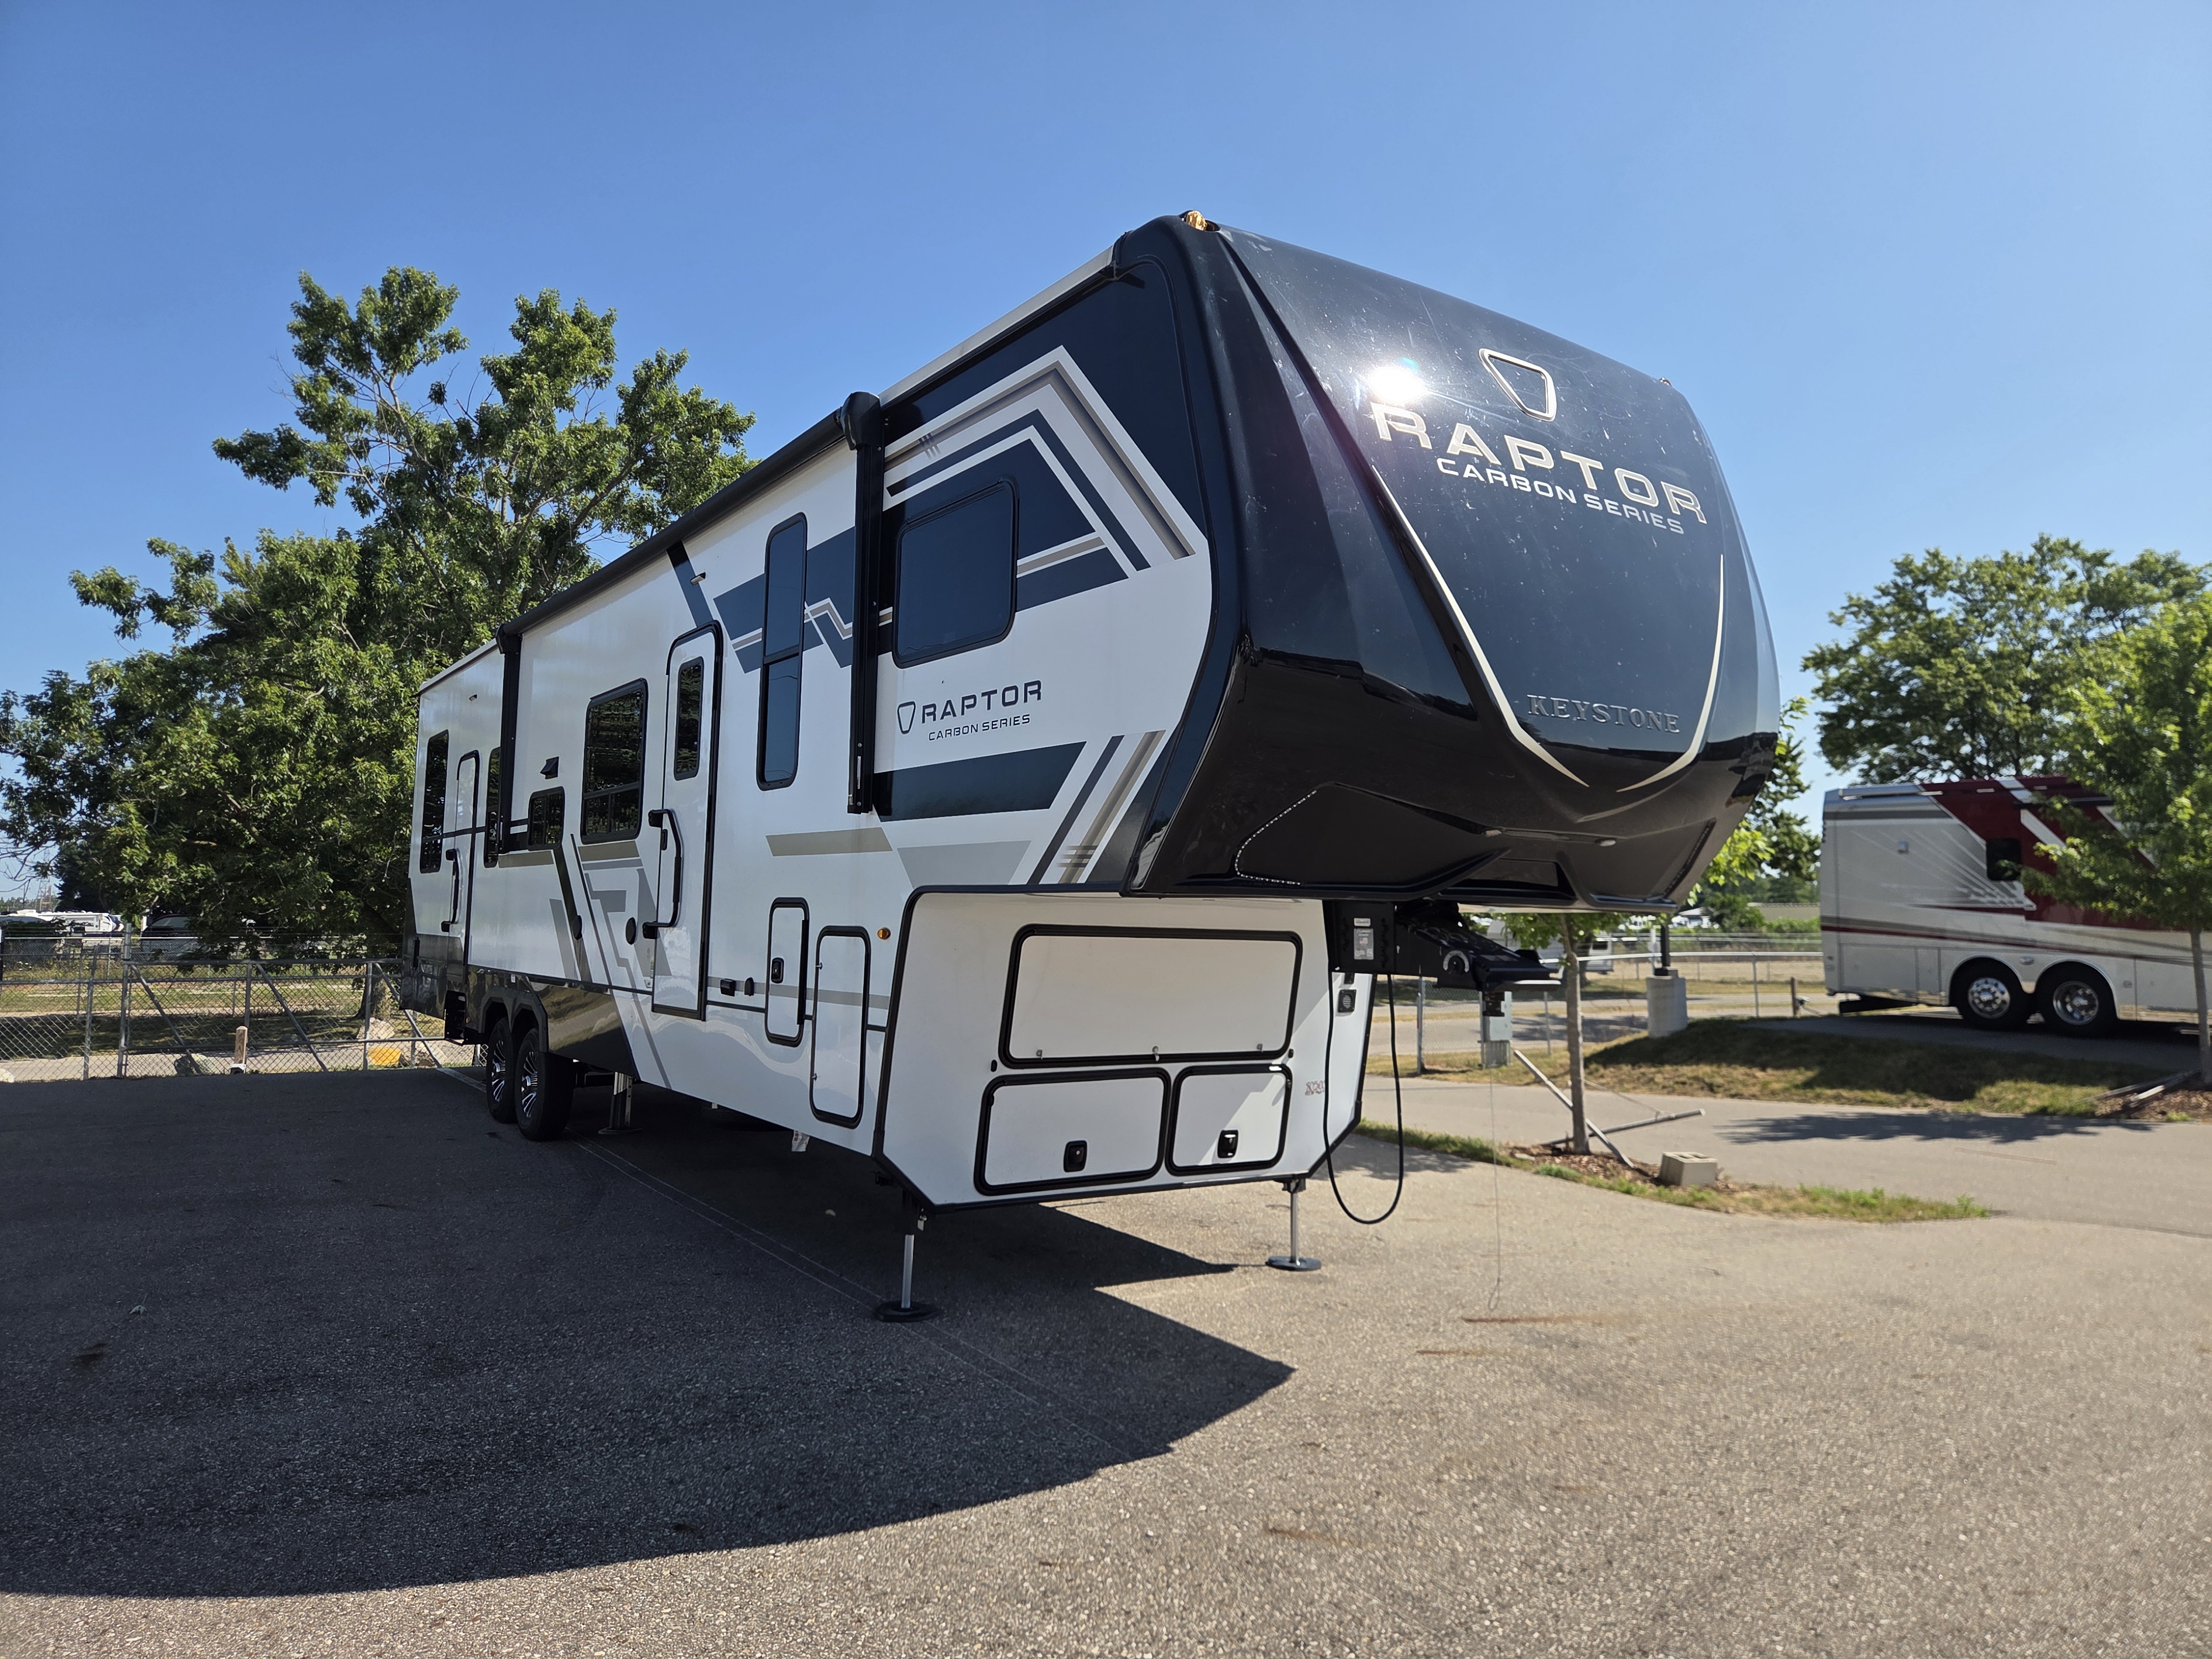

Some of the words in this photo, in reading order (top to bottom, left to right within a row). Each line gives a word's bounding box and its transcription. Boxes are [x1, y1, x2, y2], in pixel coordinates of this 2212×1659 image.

[1369, 401, 1707, 524] RAPTOR
[1437, 457, 1577, 504] CARBON
[1586, 495, 1684, 535] SERIES
[921, 680, 1041, 724] RAPTOR
[1527, 694, 1681, 733] KEYSTONE
[928, 723, 978, 741] CARBON
[982, 713, 1031, 732] SERIES
